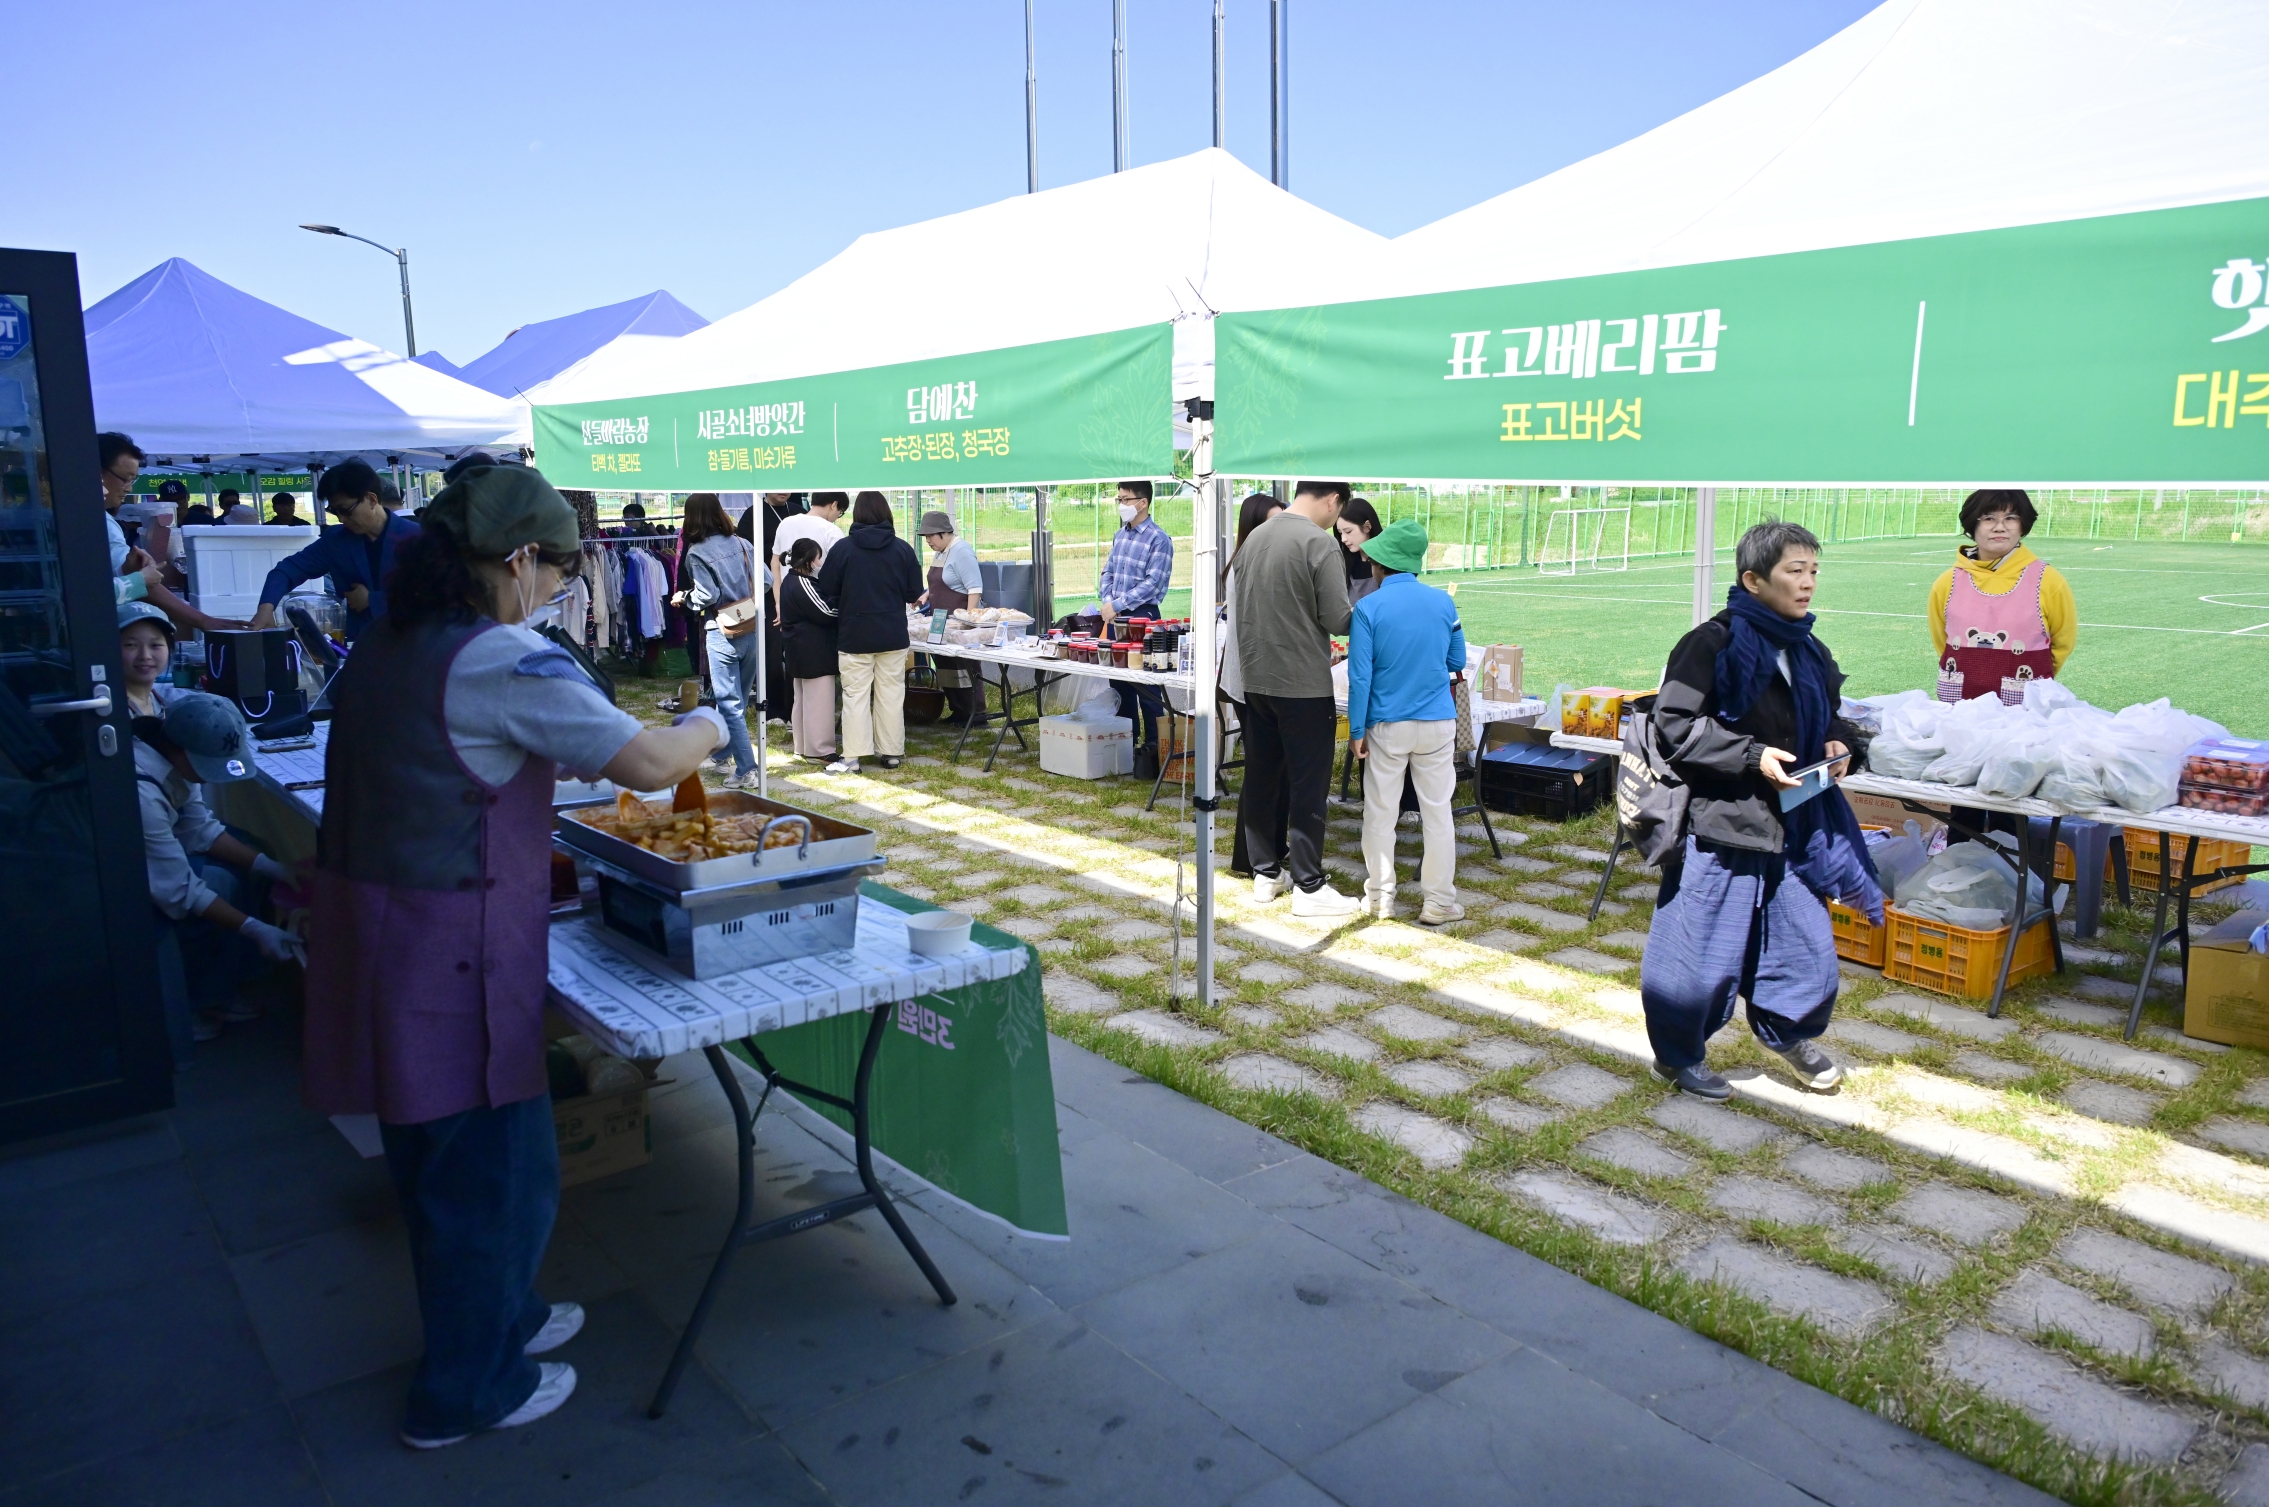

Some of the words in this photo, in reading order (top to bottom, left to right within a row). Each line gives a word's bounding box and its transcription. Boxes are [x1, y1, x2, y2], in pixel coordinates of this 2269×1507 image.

[1443, 308, 1728, 380] 표고베리팜
[907, 380, 978, 424] 담에찬
[581, 415, 650, 446] 산들바람농장
[697, 400, 806, 440] 시골소녀방앗간
[1500, 397, 1642, 442] 표고버섯
[753, 445, 797, 470] 미숫가루
[961, 426, 1011, 458] 청국장
[591, 453, 607, 473] 티백
[617, 453, 642, 473] 젤라또
[1160, 738, 1183, 748] THNK
